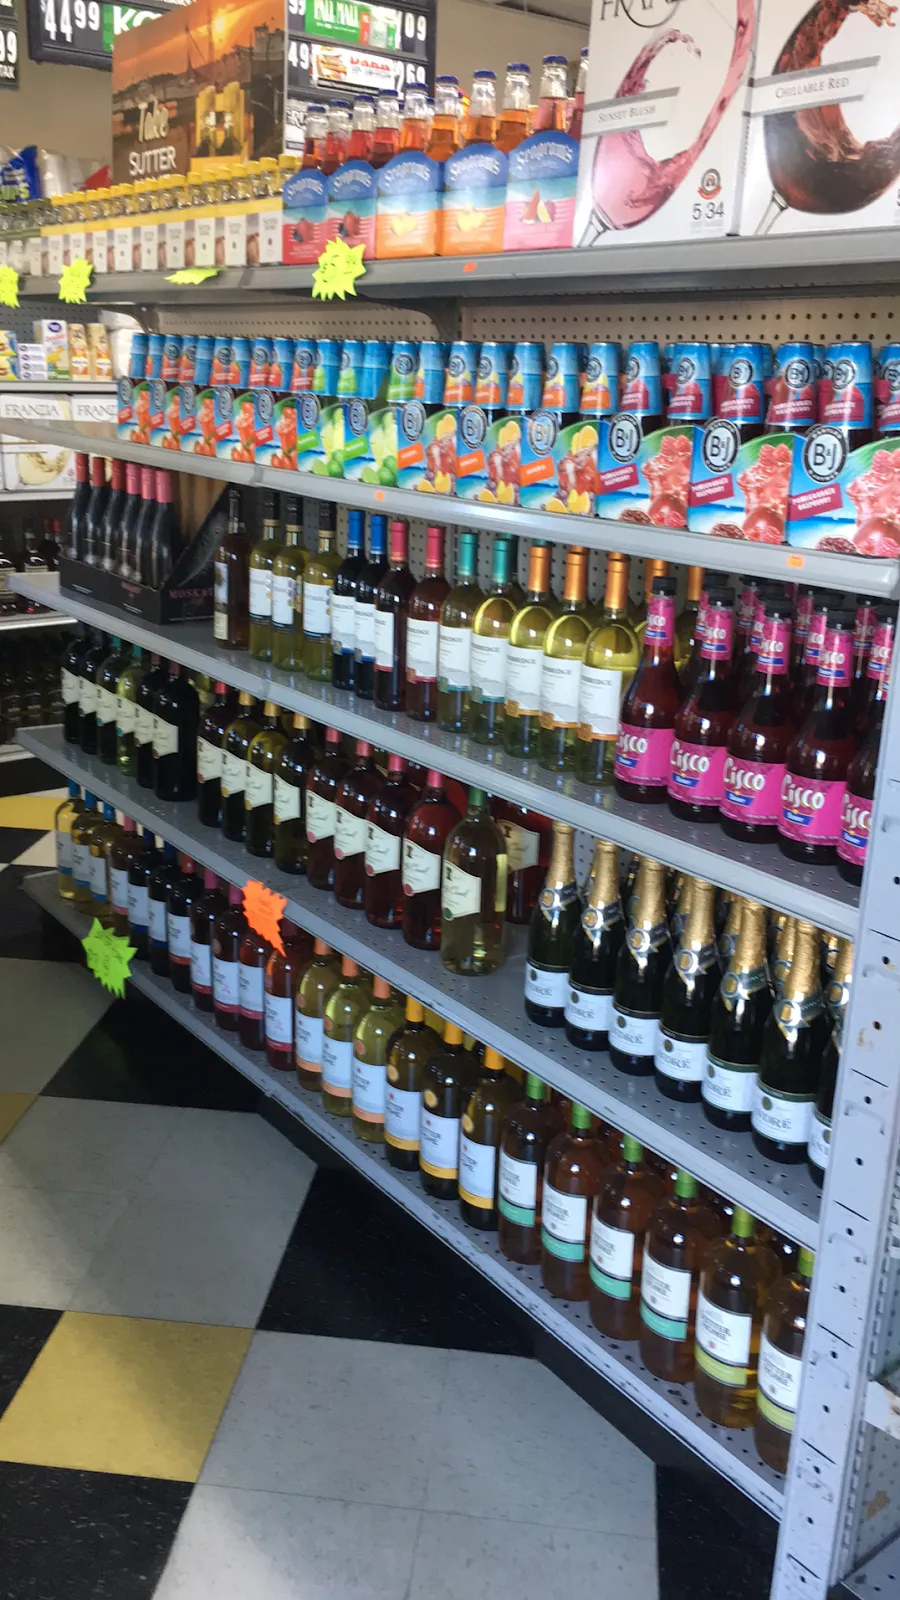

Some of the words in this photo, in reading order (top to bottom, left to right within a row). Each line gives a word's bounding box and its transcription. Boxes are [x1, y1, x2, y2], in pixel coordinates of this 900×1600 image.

[775, 80, 826, 99] CHILLABLE
[827, 76, 850, 90] RED
[128, 145, 177, 177] SUTTER
[4, 403, 60, 420] FRANZIA
[669, 740, 710, 773] Cisco
[723, 757, 766, 792] Cisco
[781, 773, 826, 810] Cisco
[840, 793, 873, 830] Cisc
